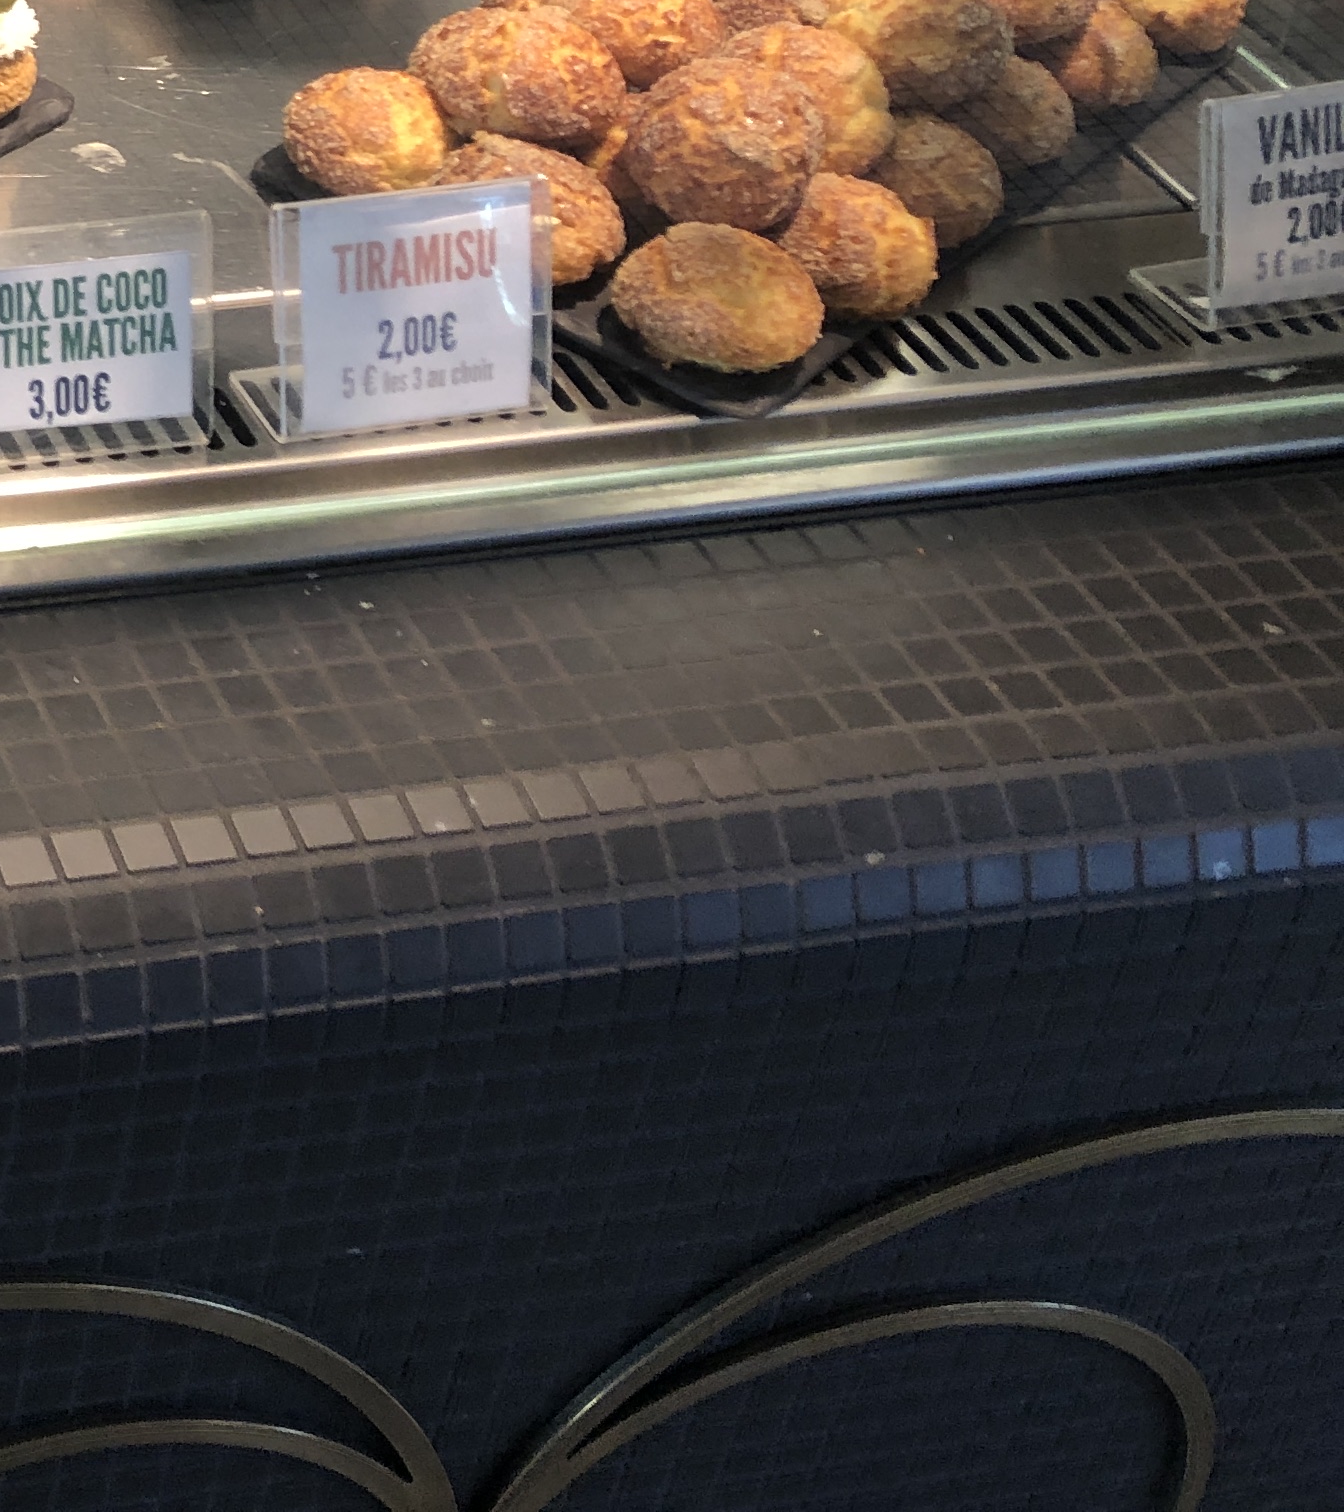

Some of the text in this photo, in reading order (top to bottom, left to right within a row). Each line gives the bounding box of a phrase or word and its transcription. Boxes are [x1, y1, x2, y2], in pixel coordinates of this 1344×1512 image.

[1278, 165, 1344, 201] Madag
[1287, 200, 1344, 245] 2,00
[332, 227, 497, 294] TIRAMISU
[52, 275, 87, 318] DE
[96, 267, 168, 314] COCO
[60, 312, 177, 362] MATCHA
[377, 312, 458, 364] 2,00€
[29, 372, 111, 424] 3,00€
[342, 367, 355, 399] 5
[363, 364, 378, 396] €
[412, 366, 423, 390] 3
[426, 368, 447, 388] au
